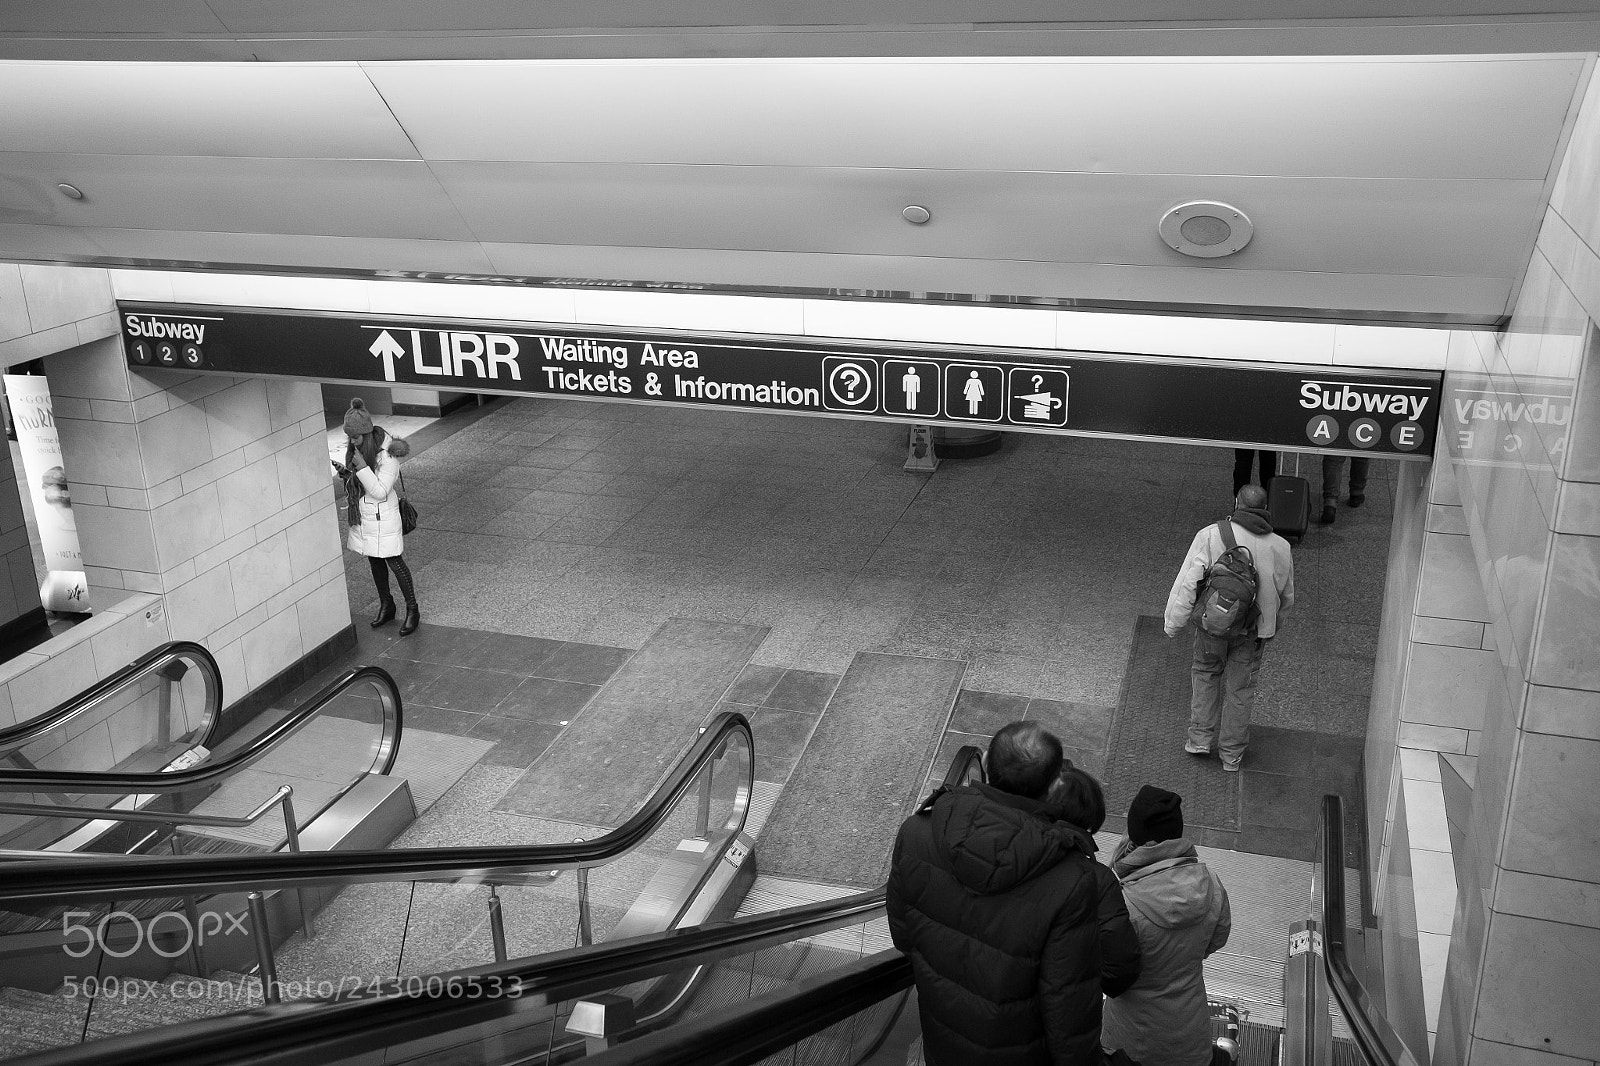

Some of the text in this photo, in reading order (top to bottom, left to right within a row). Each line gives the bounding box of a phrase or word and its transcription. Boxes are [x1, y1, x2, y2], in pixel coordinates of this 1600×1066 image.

[126, 315, 205, 345] Subway
[136, 344, 199, 363] 1 2 3
[410, 330, 522, 381] LIRR
[539, 337, 700, 369] Waiting Area
[541, 366, 820, 407] Tickets & Information
[1299, 383, 1430, 421] Subway
[1313, 420, 1416, 446] A C E
